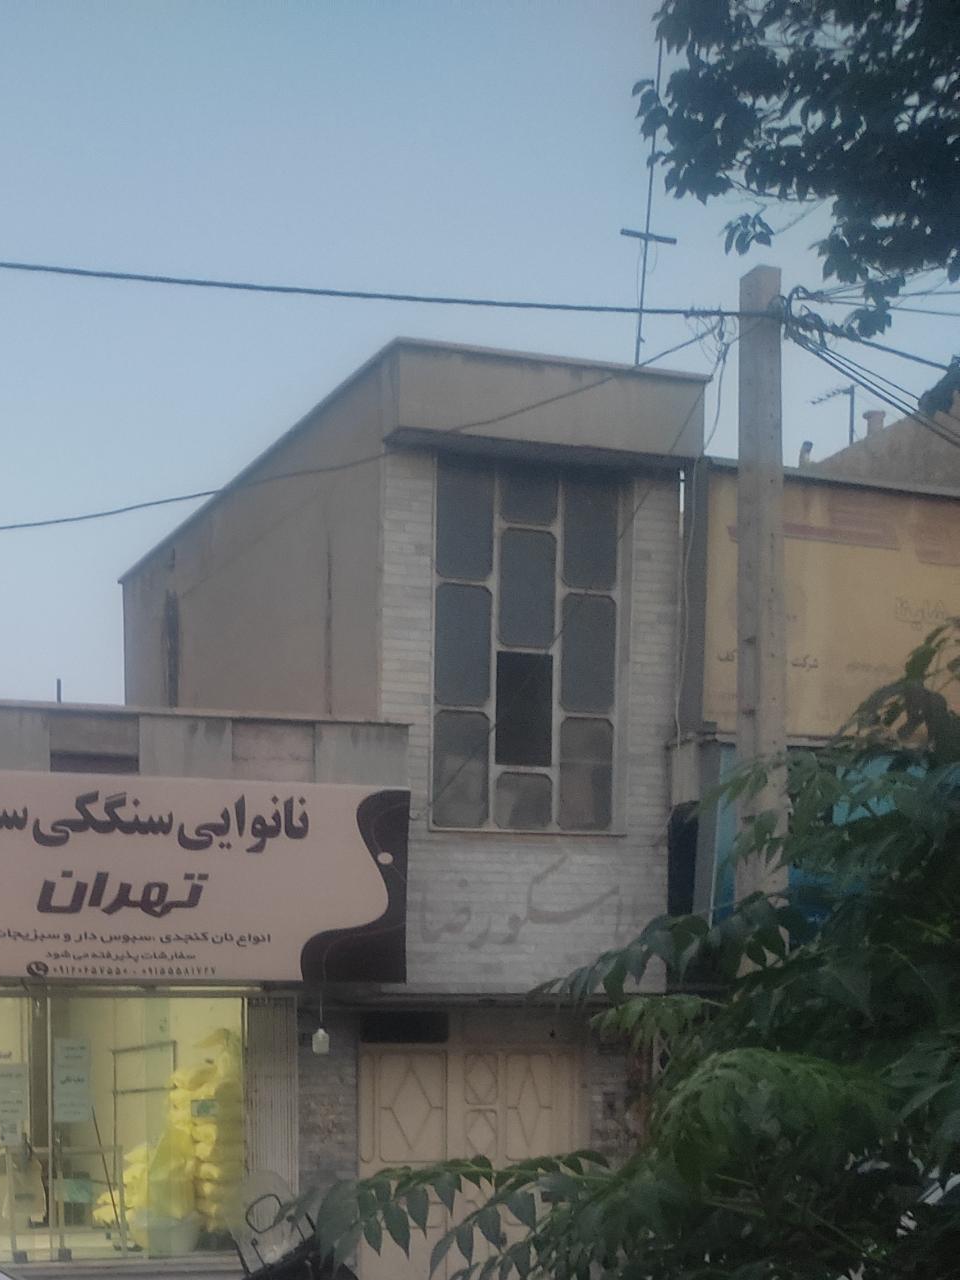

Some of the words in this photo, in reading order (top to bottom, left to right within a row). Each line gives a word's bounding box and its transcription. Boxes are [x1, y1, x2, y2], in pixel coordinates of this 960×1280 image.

[33, 790, 174, 847] سنگکی
[177, 793, 311, 853] نانوایی
[36, 870, 210, 918] تهران
[62, 931, 72, 943] و
[74, 930, 97, 944] دار
[159, 930, 209, 944] کنجدی
[211, 929, 234, 944] نان
[236, 931, 271, 947] انواع
